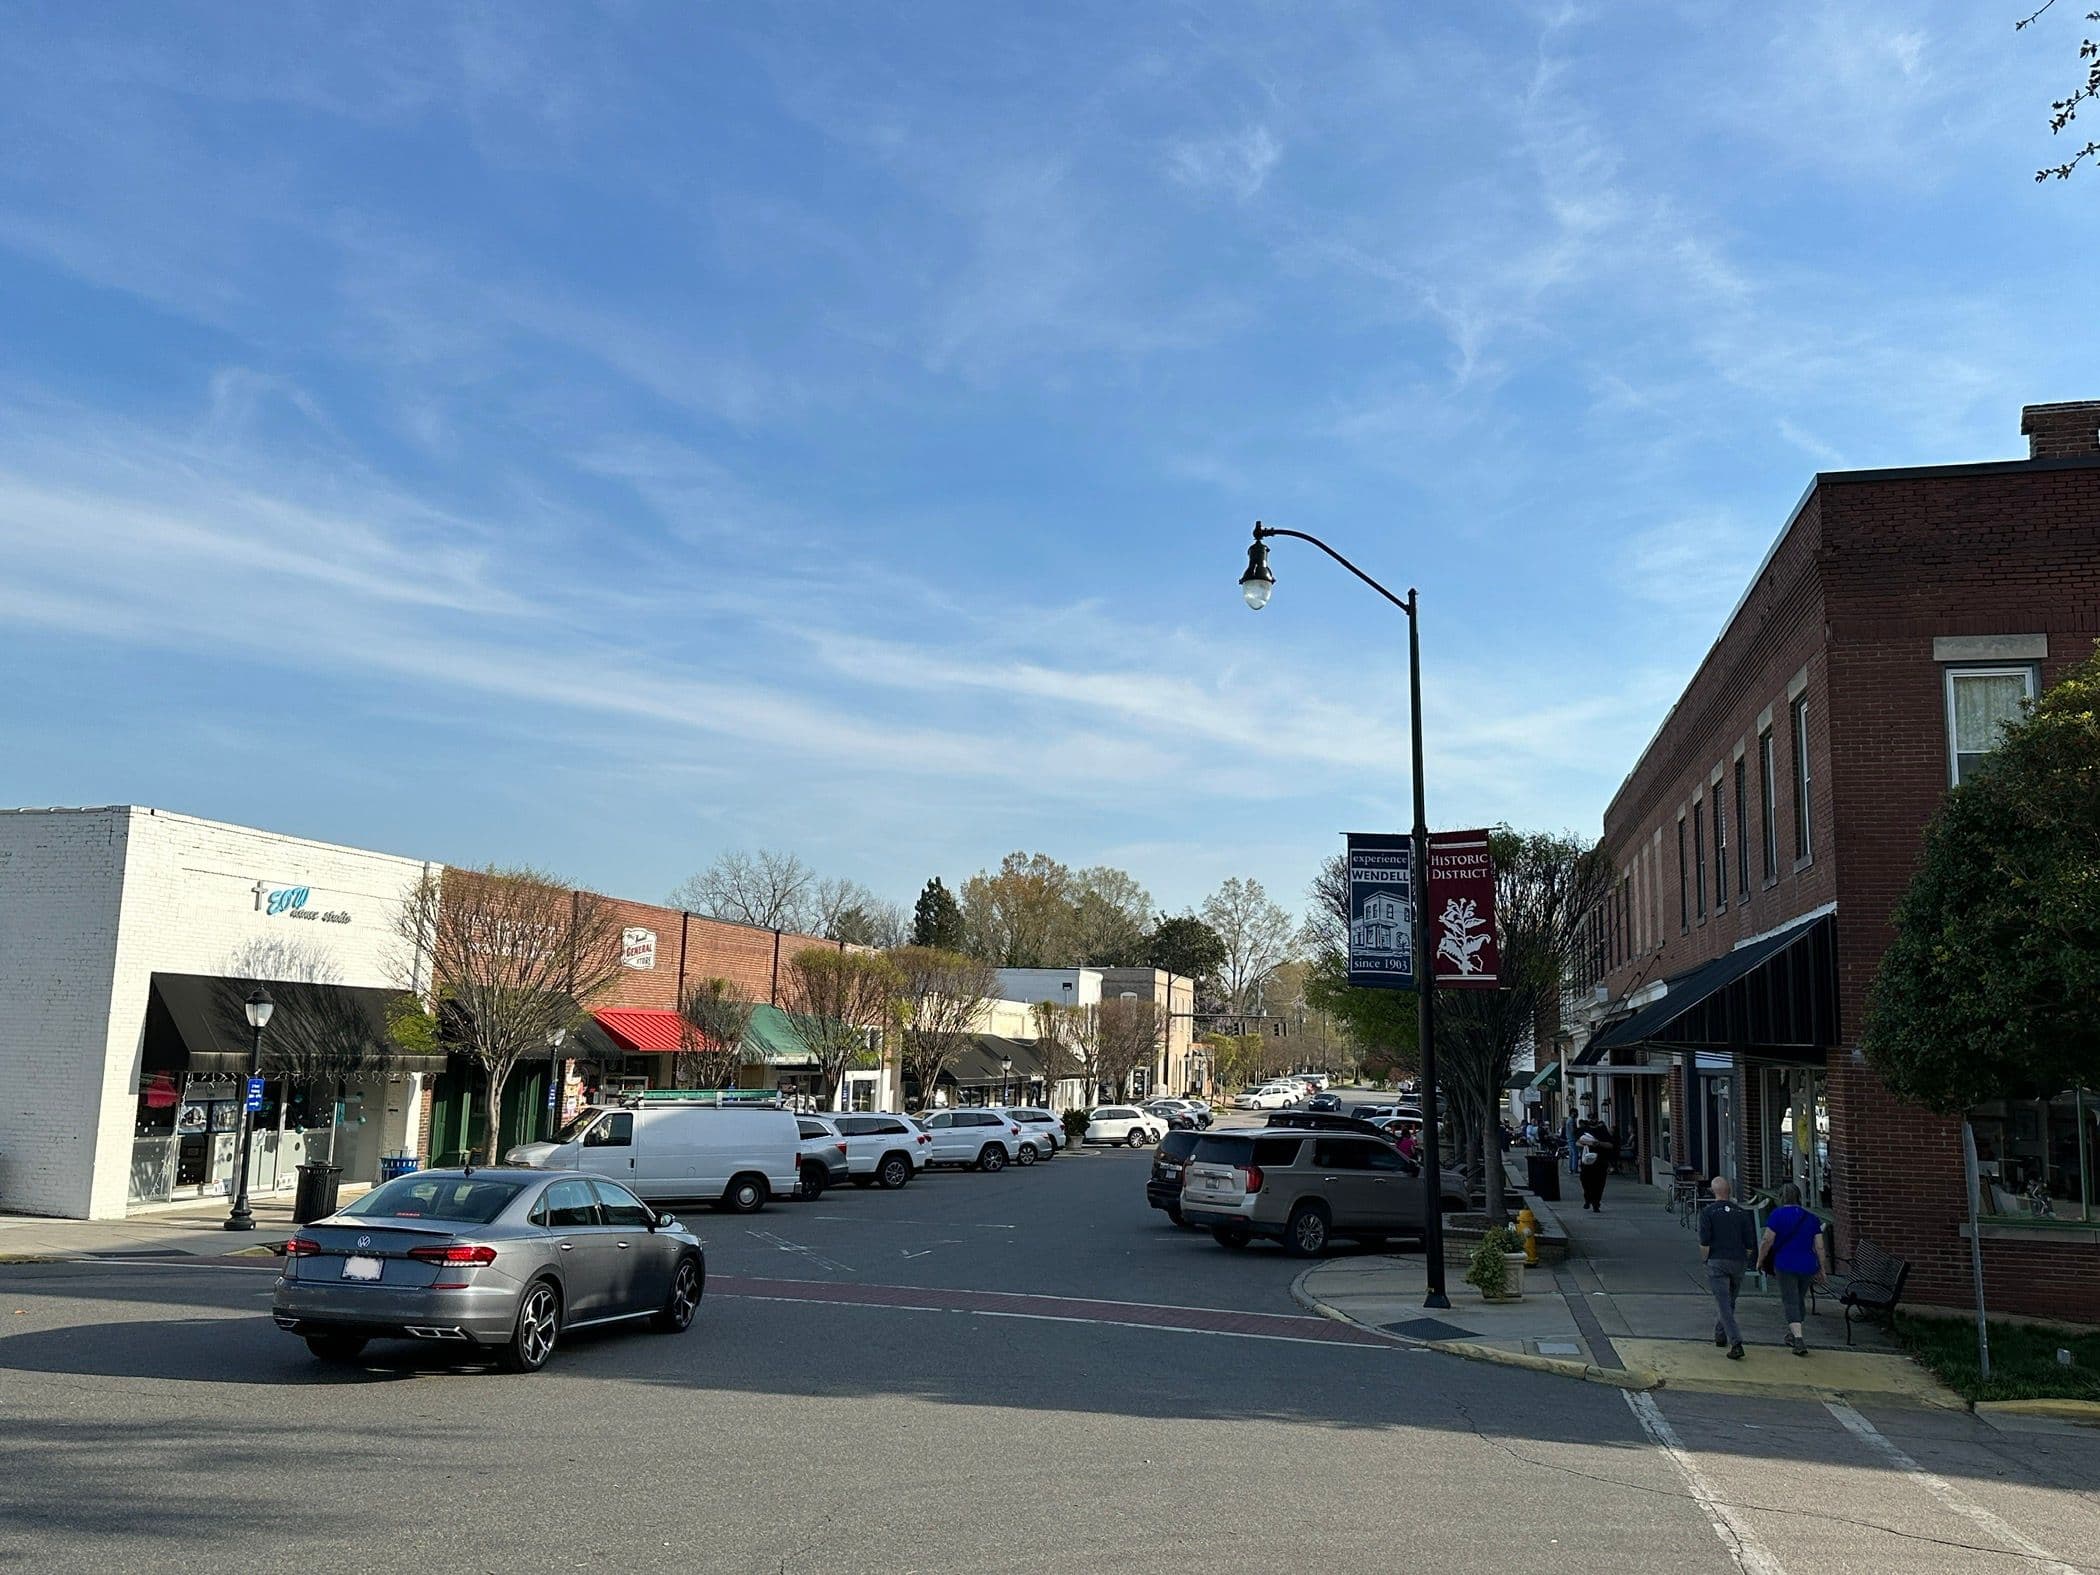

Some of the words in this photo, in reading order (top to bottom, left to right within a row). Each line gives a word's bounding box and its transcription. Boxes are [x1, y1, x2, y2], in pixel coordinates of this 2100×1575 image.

[1353, 853, 1407, 866] experience
[1431, 854, 1488, 866] HISTORIC
[1352, 870, 1409, 881] WENDELL
[1432, 868, 1488, 880] DISTRICT
[626, 943, 652, 957] GENERAL
[1354, 958, 1381, 969] since
[1385, 959, 1408, 971] 1903
